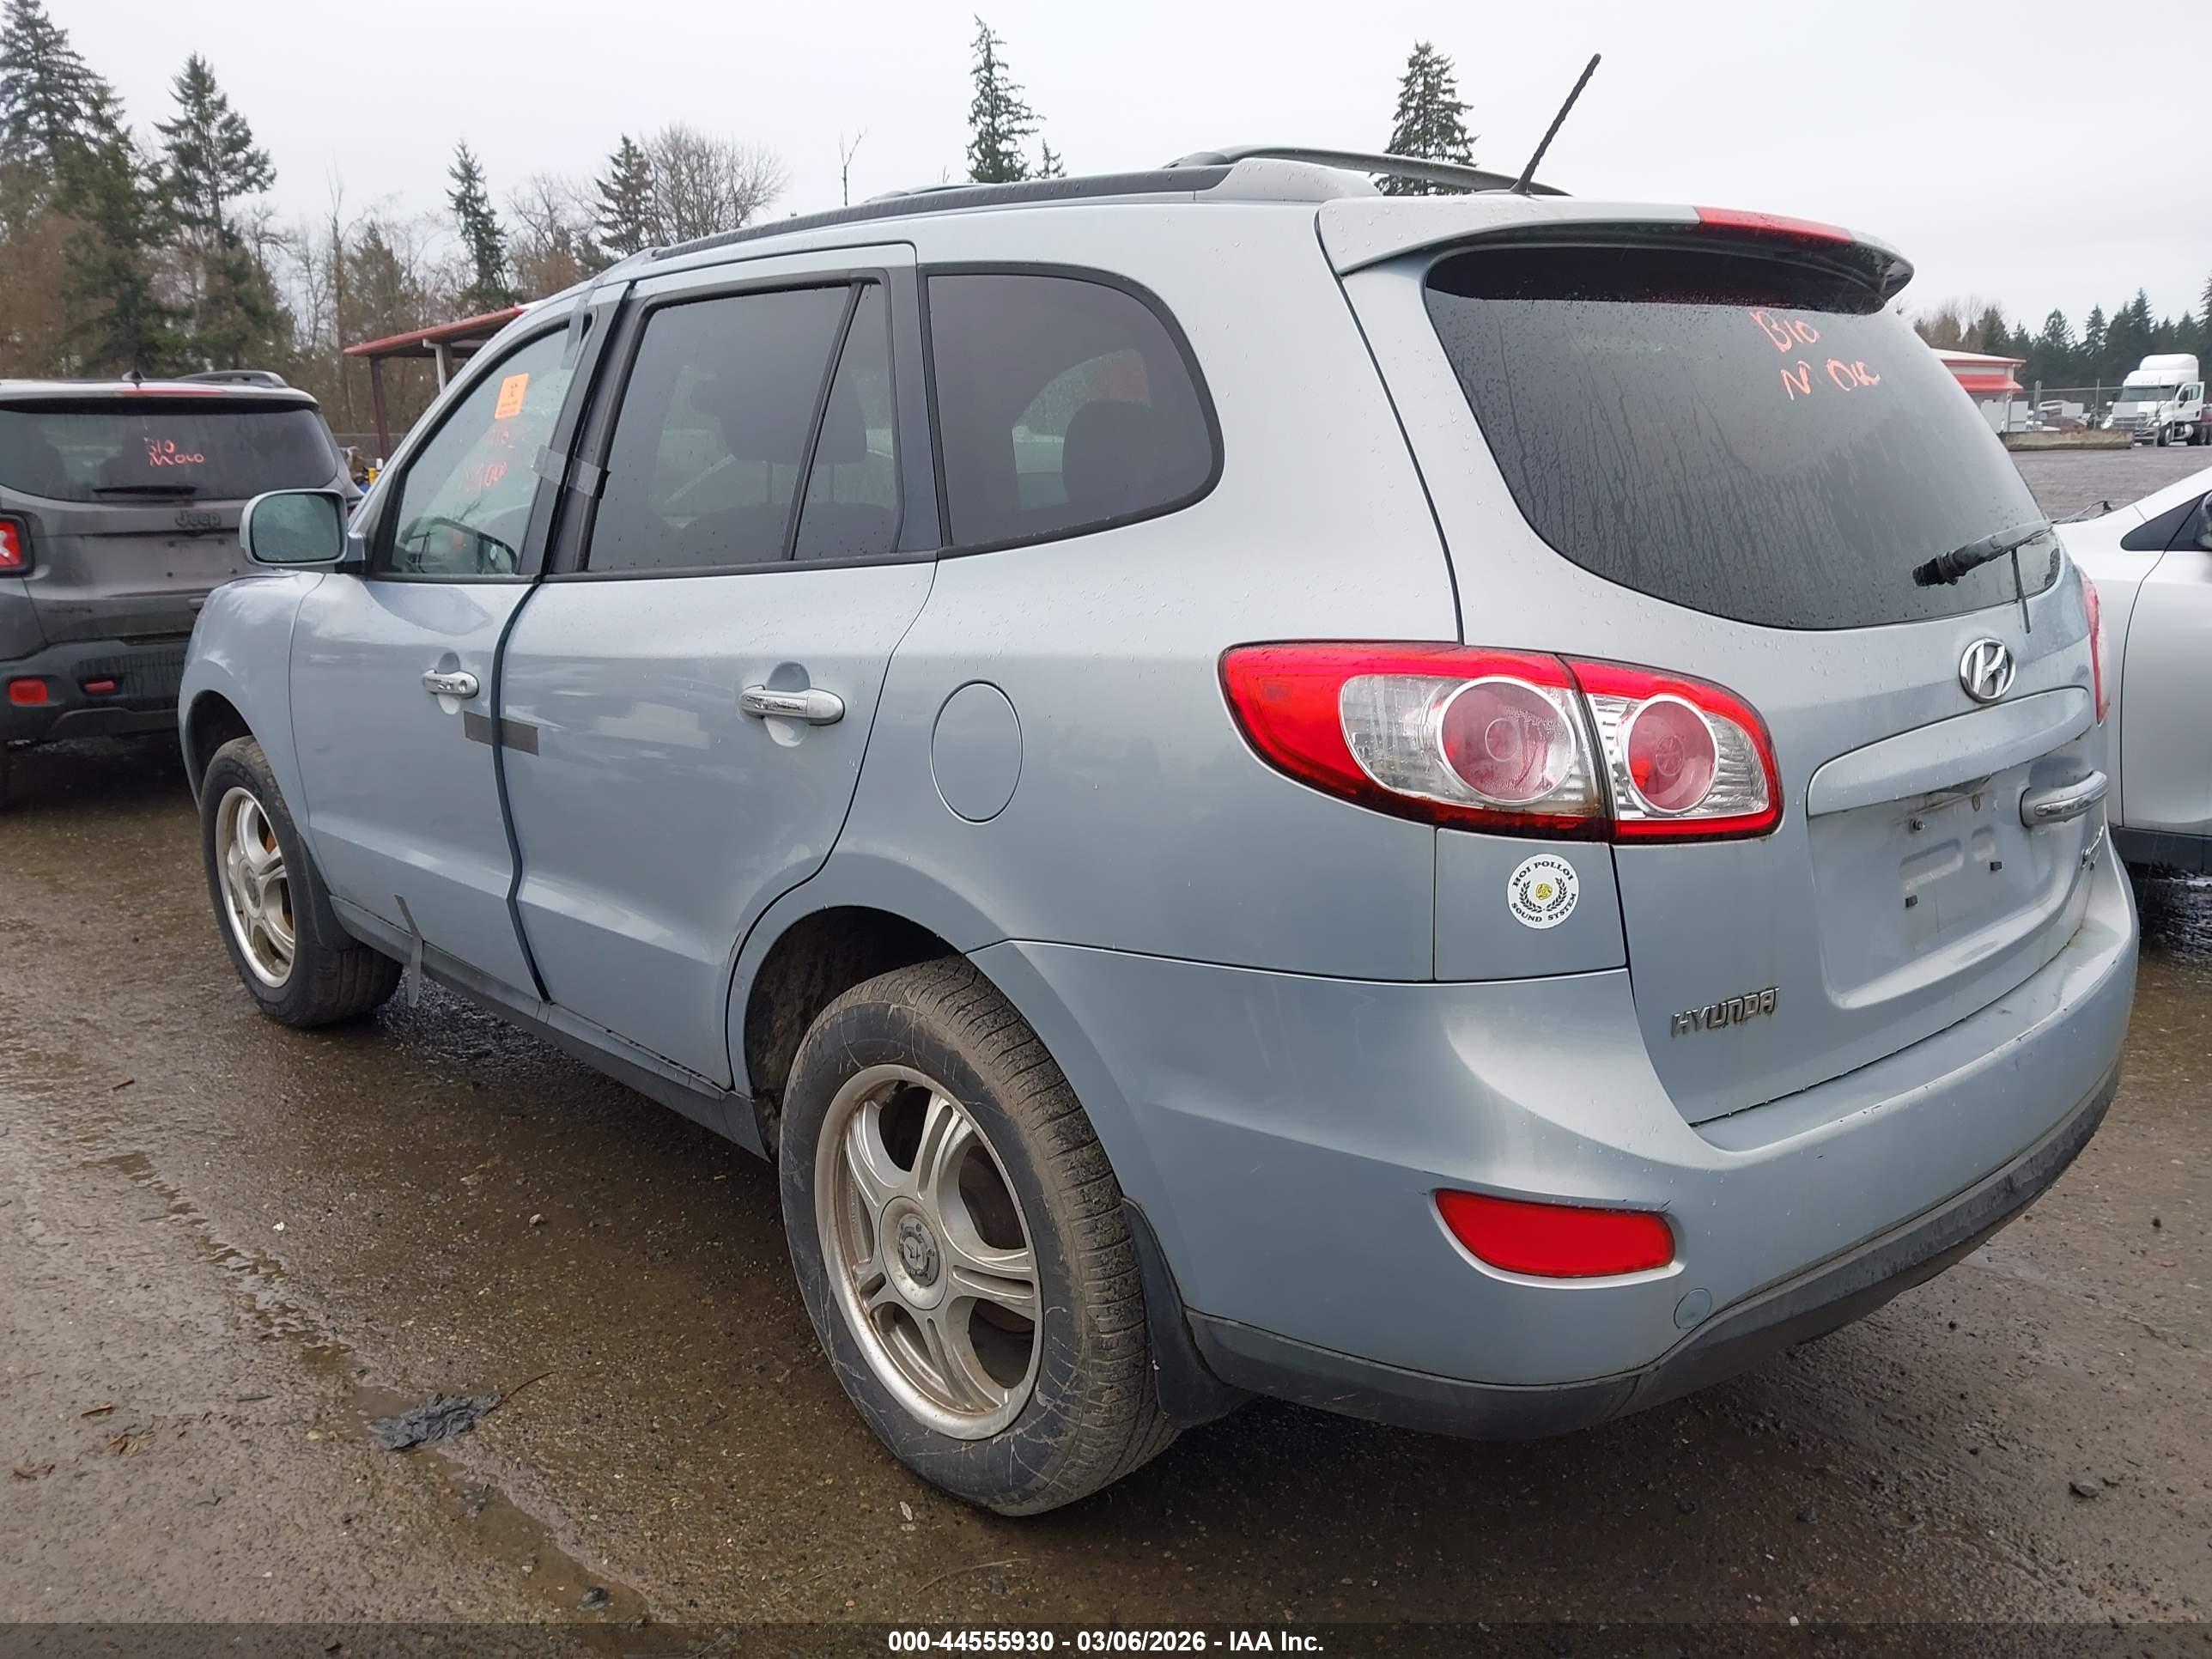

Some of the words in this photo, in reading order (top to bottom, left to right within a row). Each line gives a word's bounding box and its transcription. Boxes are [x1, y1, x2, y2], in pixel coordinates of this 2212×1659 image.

[174, 509, 222, 529] Jeep
[1512, 866, 1531, 888] HOI
[1533, 860, 1574, 882] POLLOI
[1511, 902, 1543, 923] SOUND
[1547, 892, 1577, 921] SYSTEM
[1670, 987, 1780, 1037] HYUNDAI
